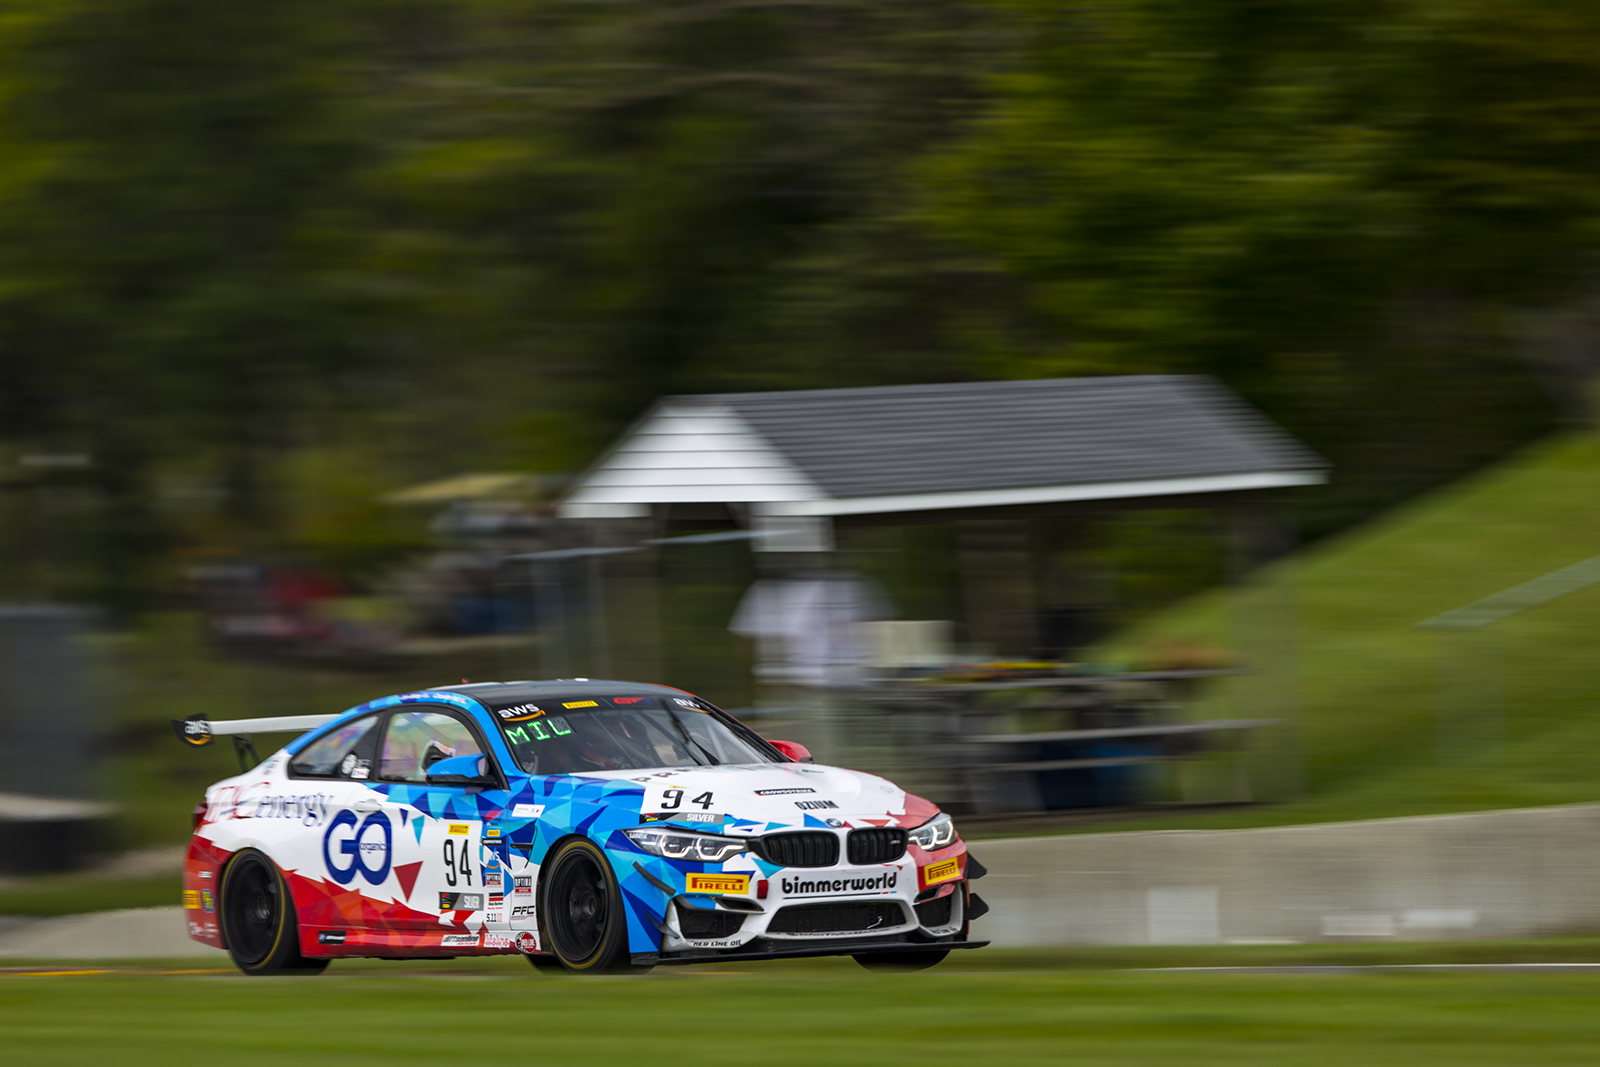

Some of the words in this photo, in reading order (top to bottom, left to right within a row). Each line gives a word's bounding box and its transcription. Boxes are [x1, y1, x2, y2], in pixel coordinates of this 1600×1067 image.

[498, 703, 540, 718] aws
[673, 697, 701, 708] aw
[504, 718, 572, 746] MIL
[661, 789, 715, 810] 94
[794, 800, 840, 810] OZIUM
[686, 813, 715, 823] SILVER
[323, 808, 392, 886] GO
[443, 838, 472, 887] 94
[929, 861, 958, 879] PIRELLI
[691, 876, 744, 892] PIRELLI
[781, 871, 897, 895] bimmerworld
[512, 905, 535, 916] PFC
[730, 939, 741, 947] OIL
